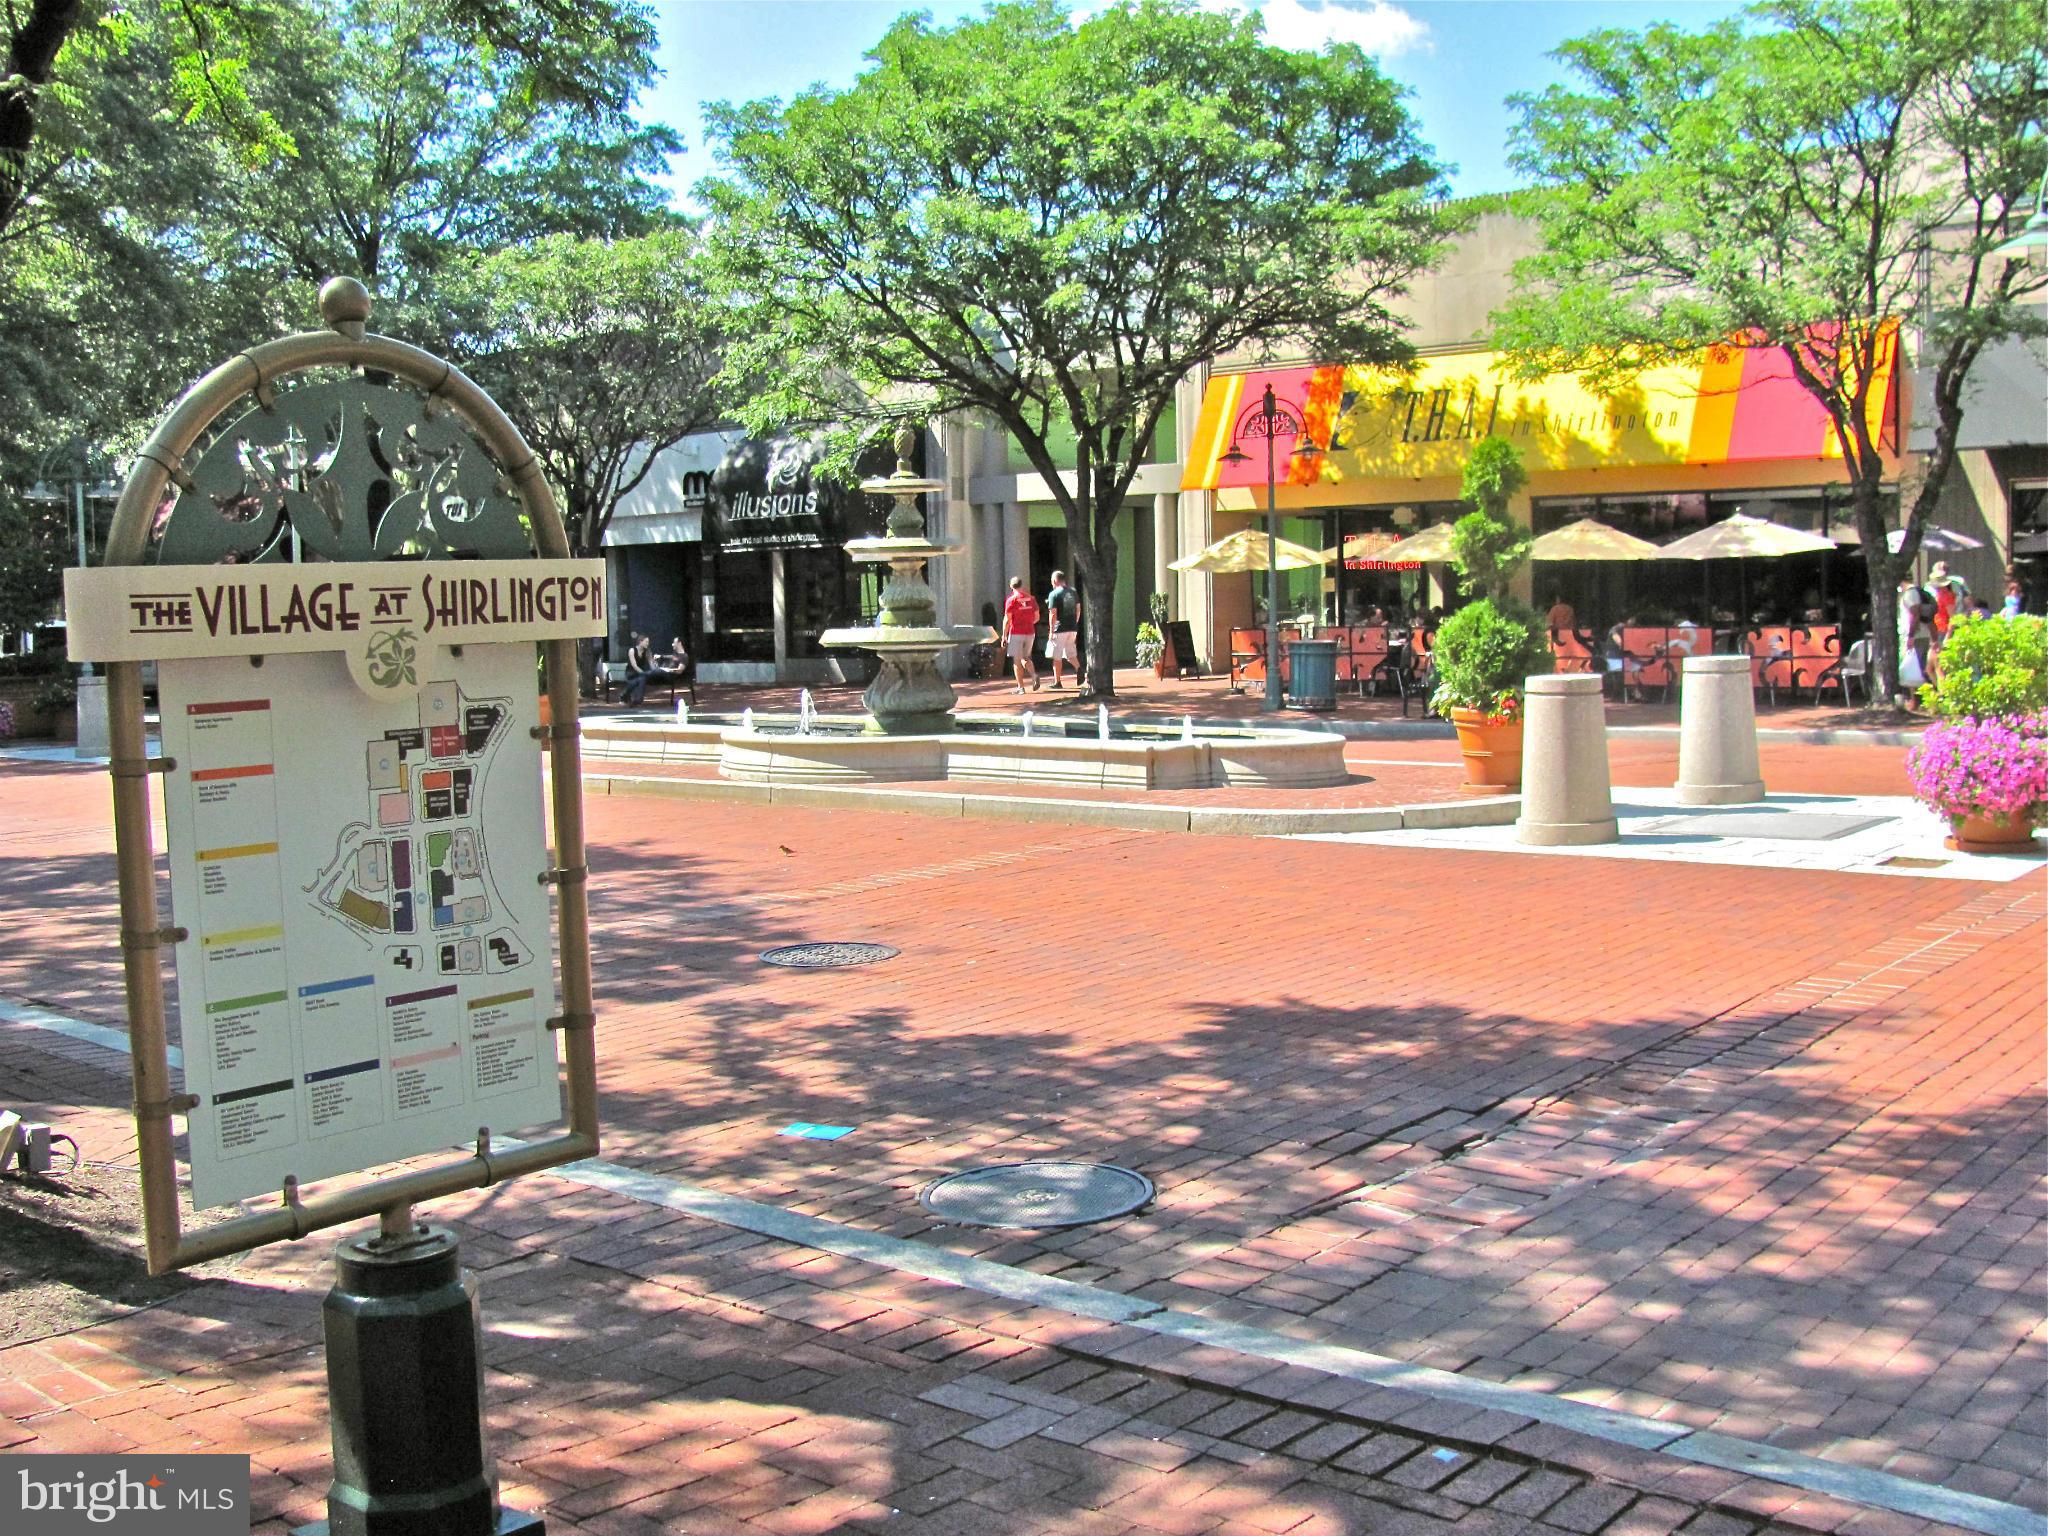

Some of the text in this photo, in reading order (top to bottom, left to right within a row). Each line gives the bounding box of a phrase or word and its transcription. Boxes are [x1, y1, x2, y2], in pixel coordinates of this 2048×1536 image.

[731, 490, 818, 519] illusions
[1359, 560, 1421, 571] Shirlington
[131, 574, 602, 637] THE VILLAGE AT SHIRLINGTON
